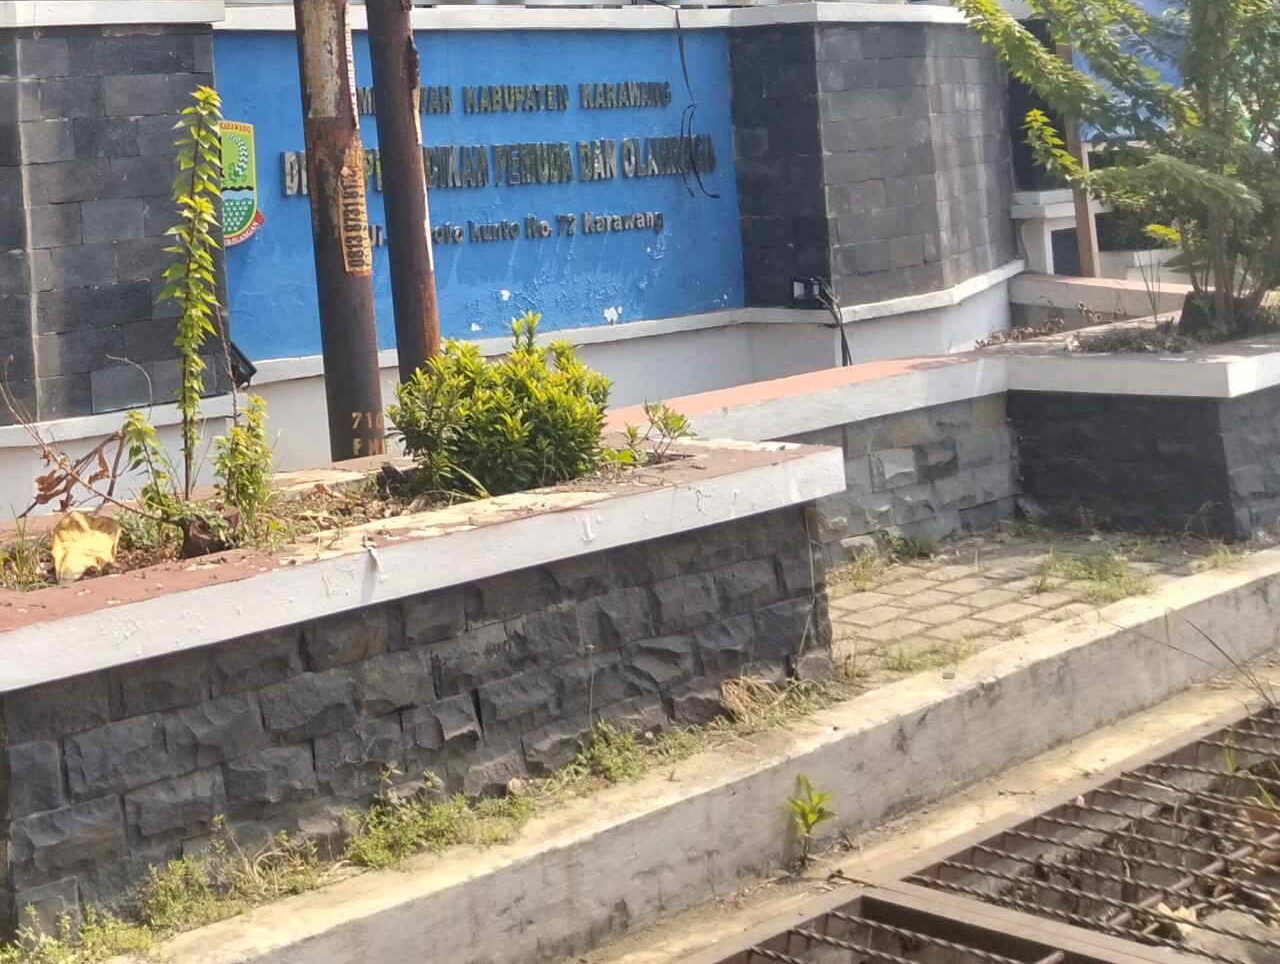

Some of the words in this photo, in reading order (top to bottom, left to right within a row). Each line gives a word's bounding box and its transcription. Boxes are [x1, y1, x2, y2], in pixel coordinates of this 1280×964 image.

[463, 83, 569, 115] KABUPATEN
[579, 81, 672, 109] KARAWANG
[365, 144, 489, 193] PDIKAN
[493, 140, 575, 187] PEMUDA
[621, 133, 717, 180] OLAHRAGA
[342, 201, 362, 233] 8731
[581, 210, 663, 235] Karawang
[344, 236, 365, 268] 0813
